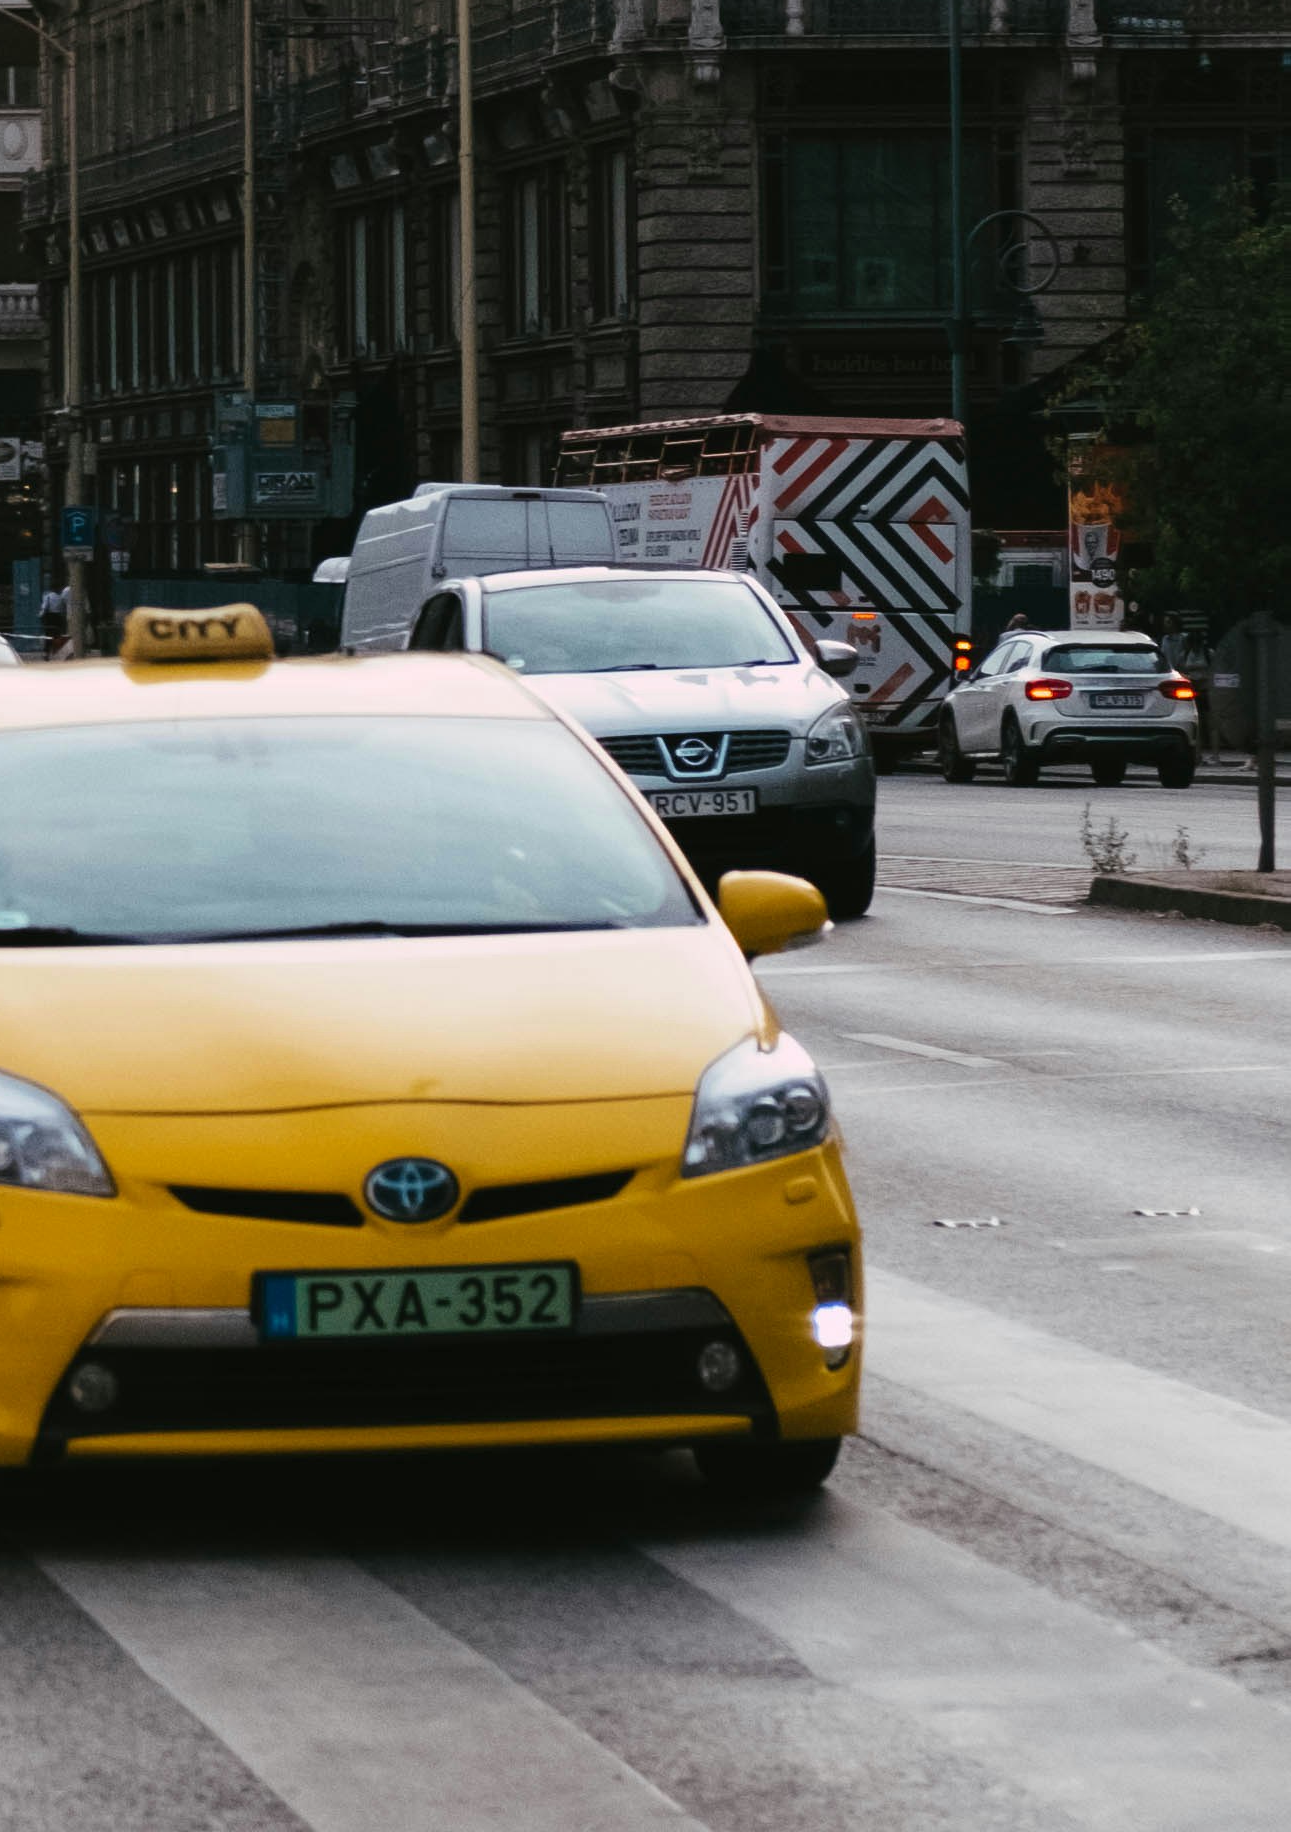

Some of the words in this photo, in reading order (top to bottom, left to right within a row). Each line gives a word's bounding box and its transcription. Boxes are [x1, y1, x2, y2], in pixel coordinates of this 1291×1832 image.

[148, 616, 239, 639] CITY
[655, 791, 750, 815] RCV-951
[308, 1273, 559, 1332] PXA-352
